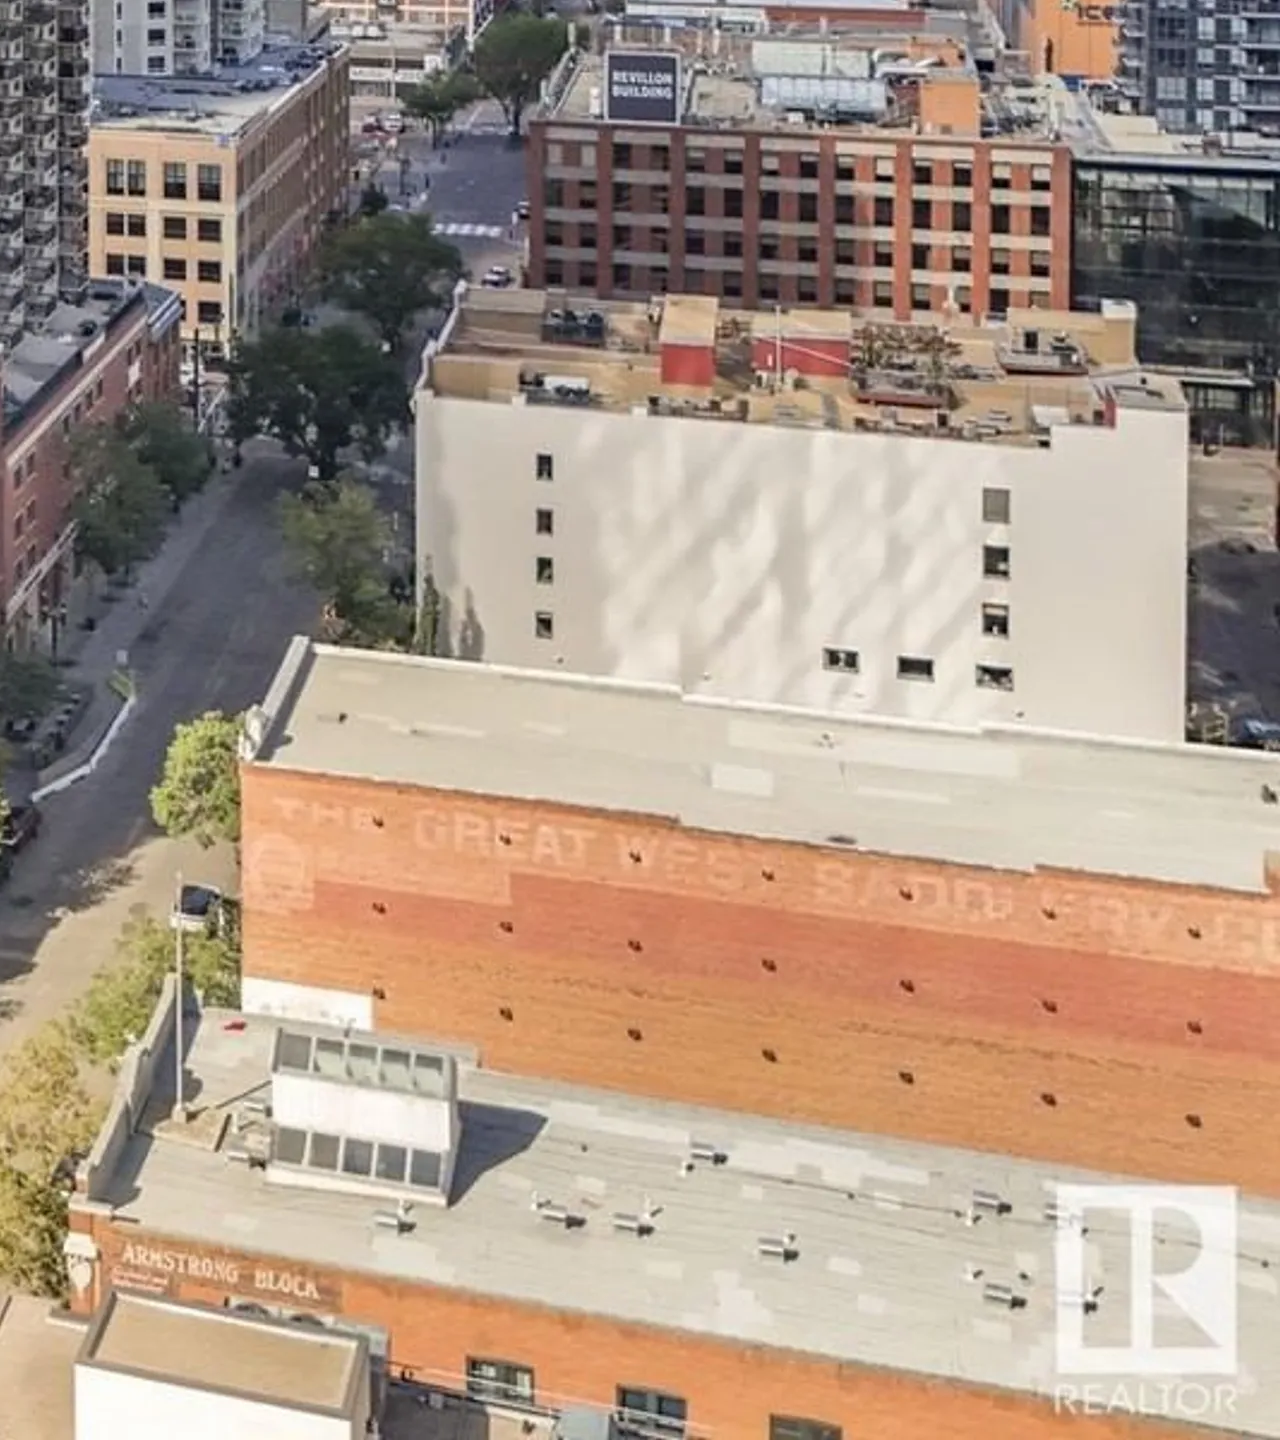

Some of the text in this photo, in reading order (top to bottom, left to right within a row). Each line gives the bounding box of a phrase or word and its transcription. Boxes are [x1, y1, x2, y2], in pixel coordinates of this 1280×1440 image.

[612, 70, 673, 85] REVILLON
[612, 85, 673, 101] BUILDING
[413, 807, 598, 866] GREAT
[122, 1243, 239, 1284] ARMSTRONG
[254, 1267, 321, 1301] BLOCK
